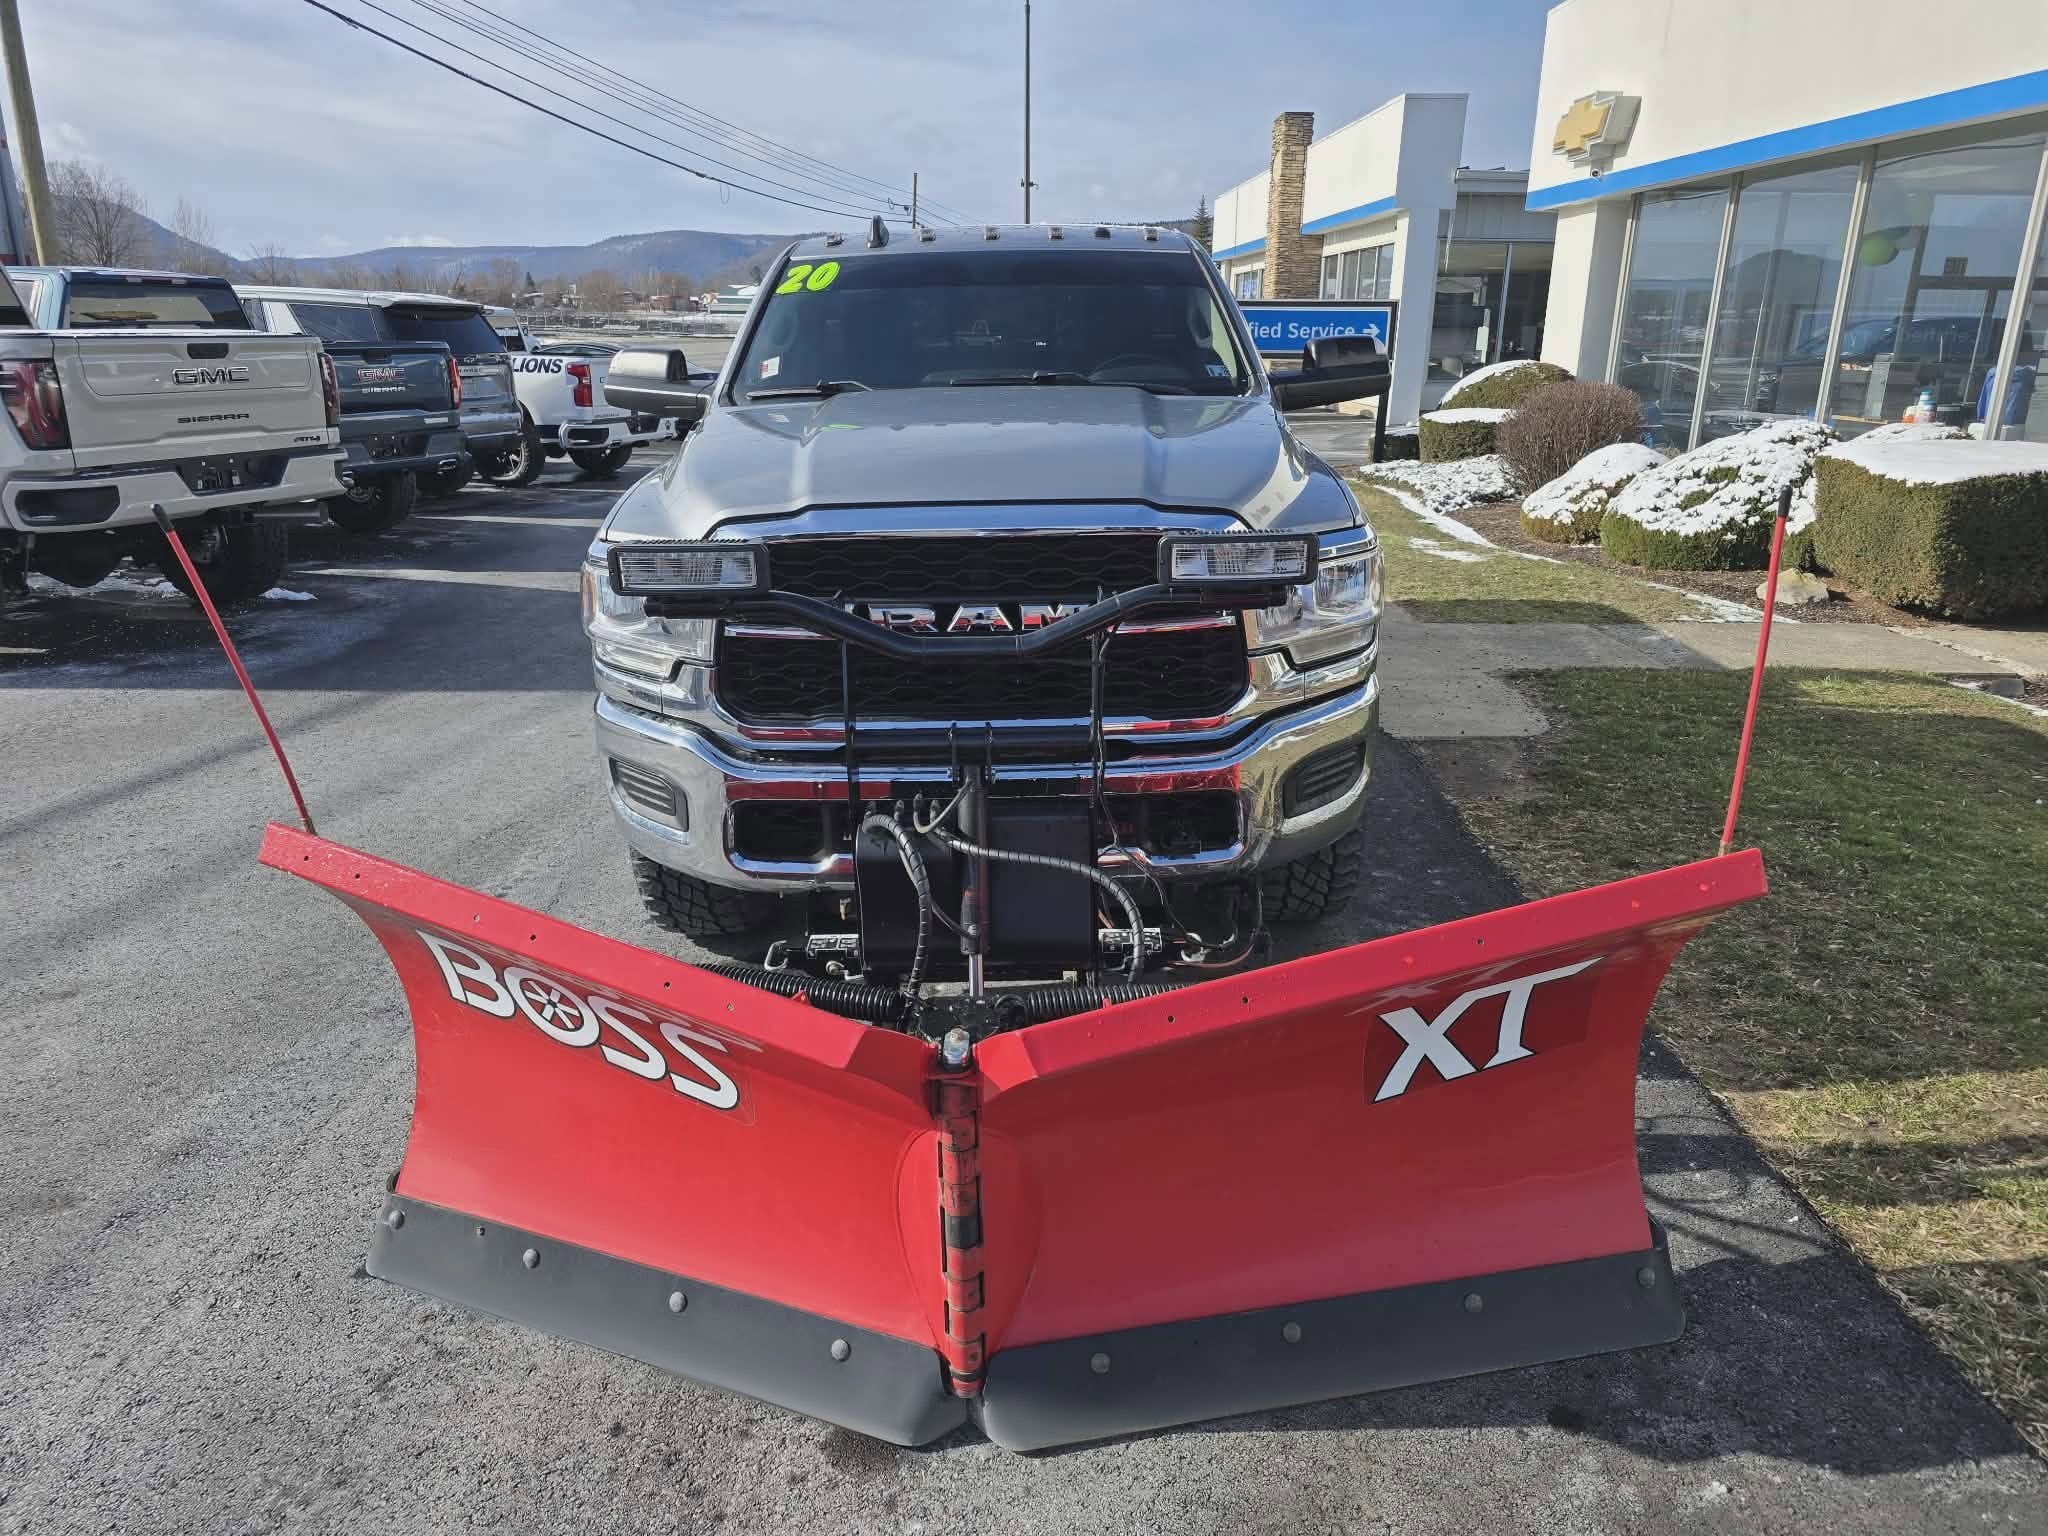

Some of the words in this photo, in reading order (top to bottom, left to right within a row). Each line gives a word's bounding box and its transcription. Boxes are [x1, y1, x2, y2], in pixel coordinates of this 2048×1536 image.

[775, 261, 841, 294] 20
[1249, 322, 1281, 338] fied
[1287, 323, 1356, 338] Service
[512, 357, 563, 373] LIONS
[172, 367, 249, 385] GMC
[357, 367, 405, 382] GMC
[361, 386, 406, 394] SIERRA
[177, 413, 249, 424] SIERRA
[868, 603, 1090, 632] RAM
[416, 929, 739, 1110] BOSS
[1372, 956, 1606, 1103] XT
